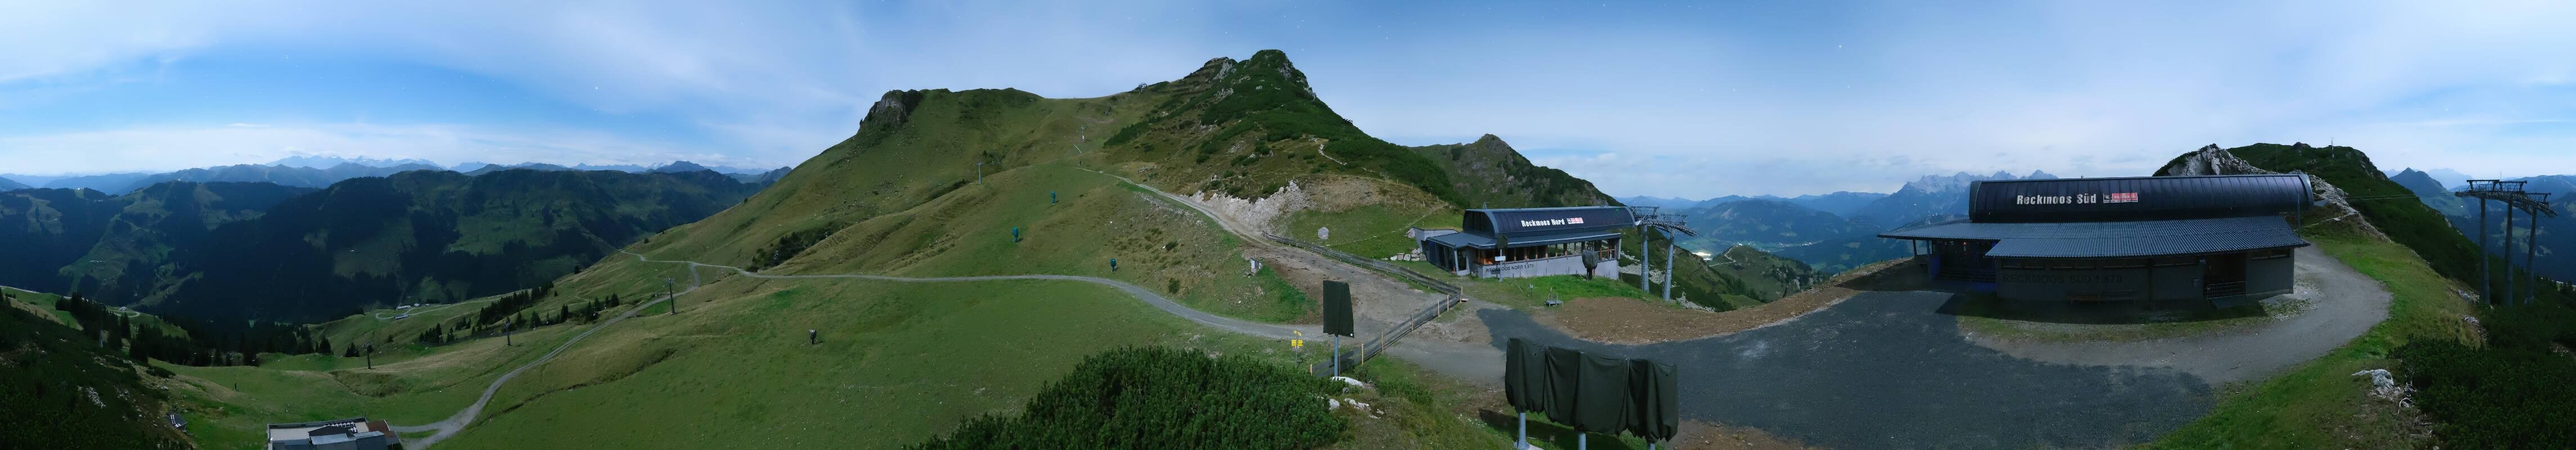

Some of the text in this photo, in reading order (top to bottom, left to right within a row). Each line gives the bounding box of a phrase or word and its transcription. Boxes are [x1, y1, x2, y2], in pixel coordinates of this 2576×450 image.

[2016, 194, 2096, 204] Reckmoos Süd
[2003, 274, 2064, 284] RECKMOOS
